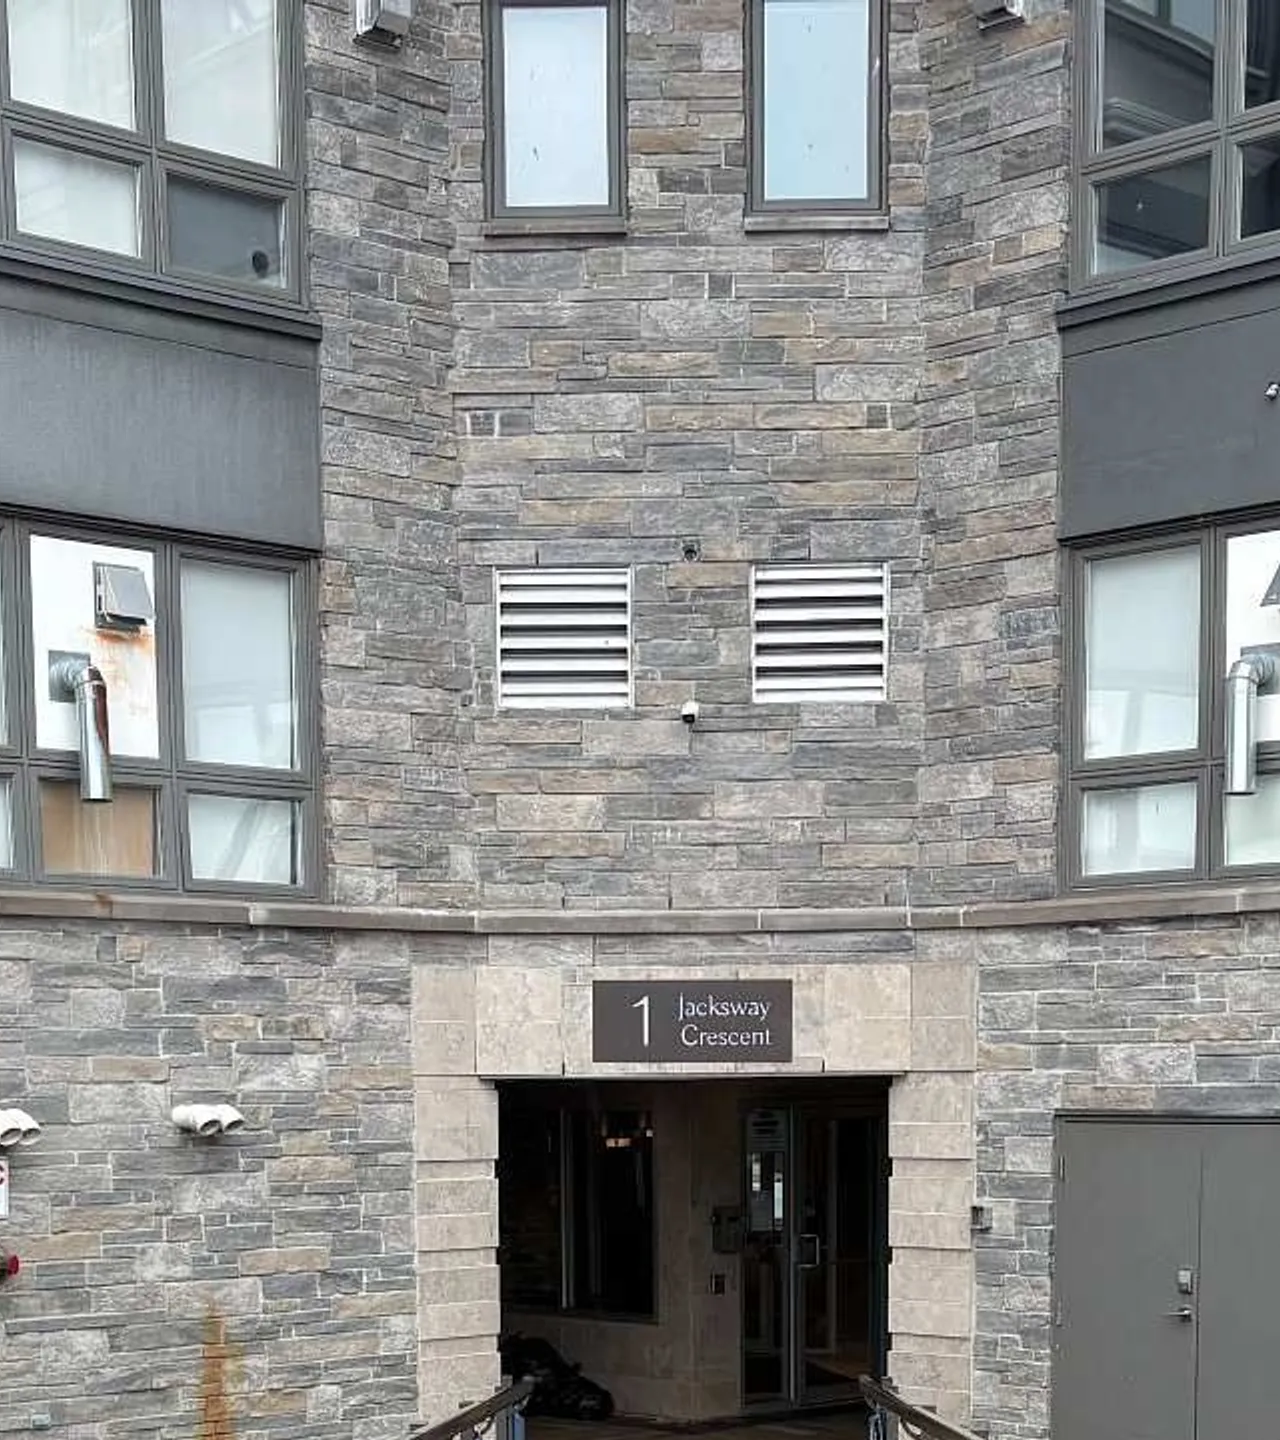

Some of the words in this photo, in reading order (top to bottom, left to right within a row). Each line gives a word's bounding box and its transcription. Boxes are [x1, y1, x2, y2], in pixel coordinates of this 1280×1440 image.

[631, 995, 650, 1047] 1
[678, 993, 770, 1021] Jacksway
[681, 1024, 772, 1046] Crescent
